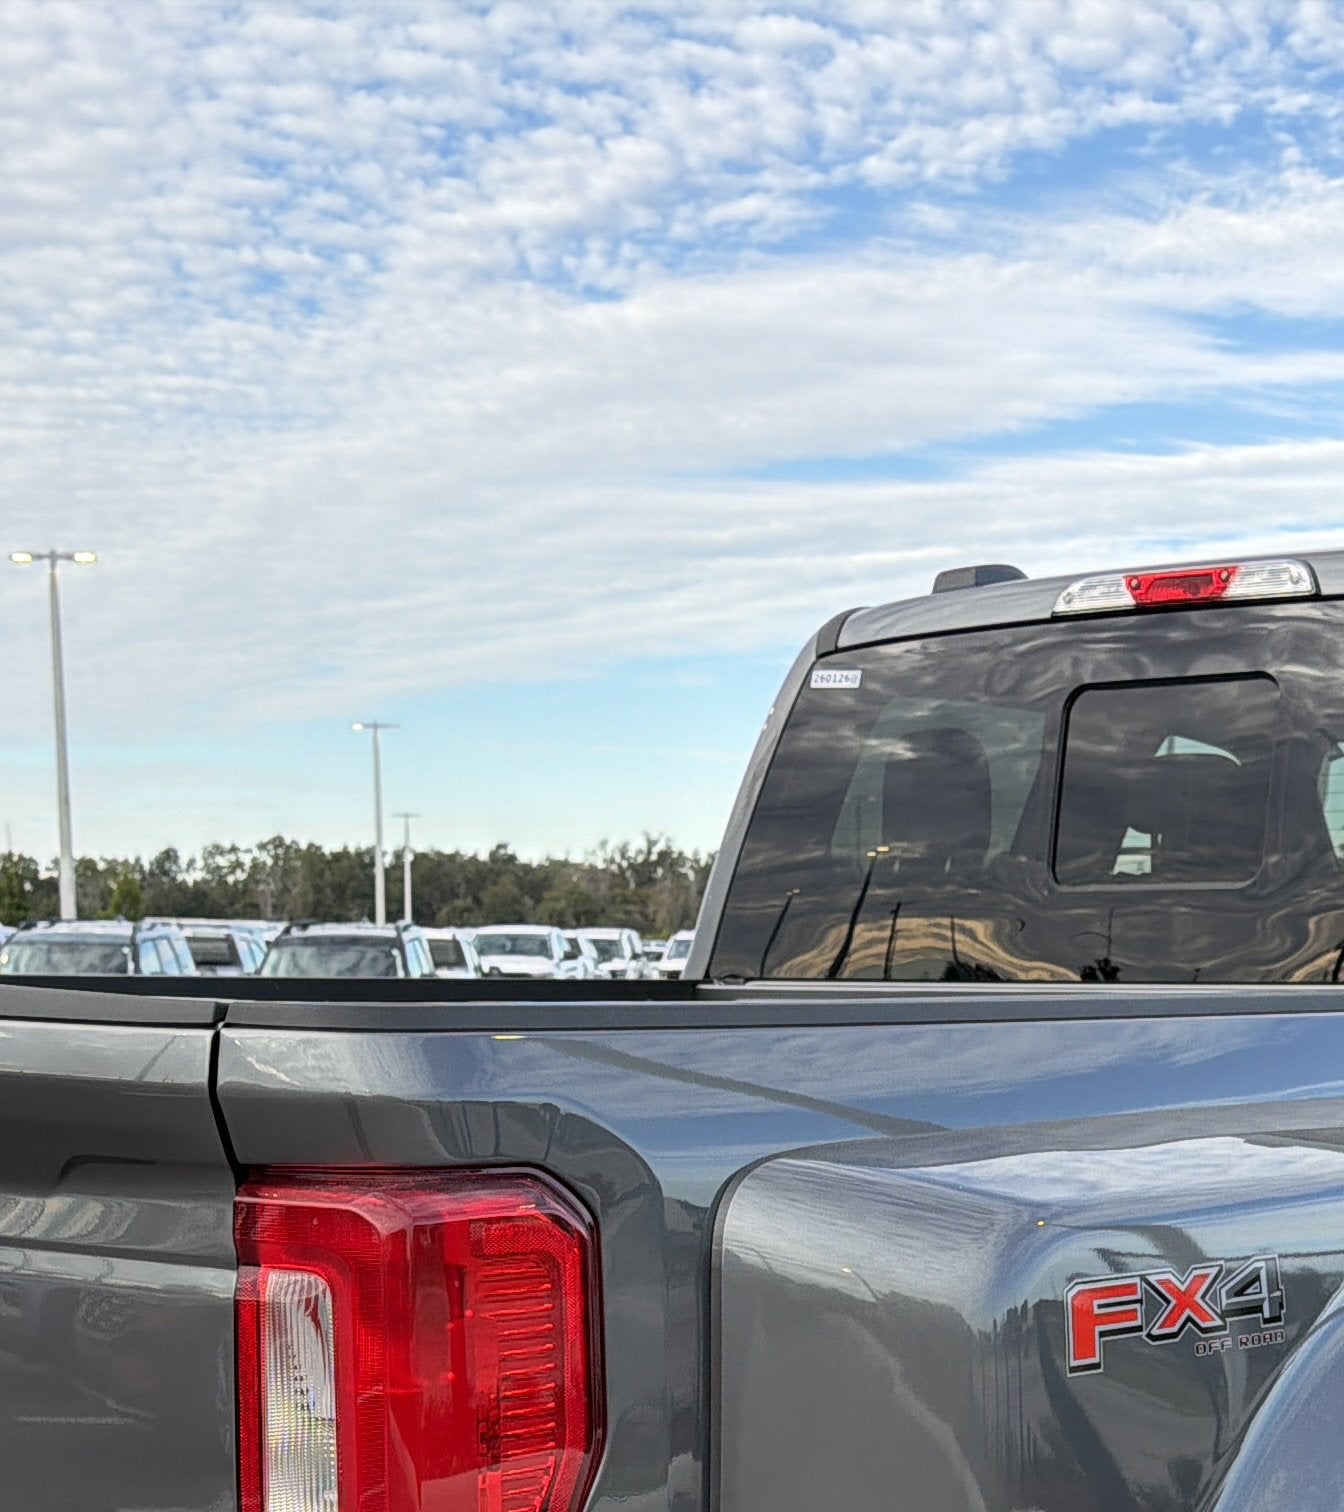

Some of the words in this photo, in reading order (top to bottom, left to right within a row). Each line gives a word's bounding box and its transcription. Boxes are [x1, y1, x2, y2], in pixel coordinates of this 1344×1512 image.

[1063, 1254, 1285, 1377] FX4
[1194, 1337, 1233, 1357] OFF
[1238, 1329, 1286, 1349] ROAD
